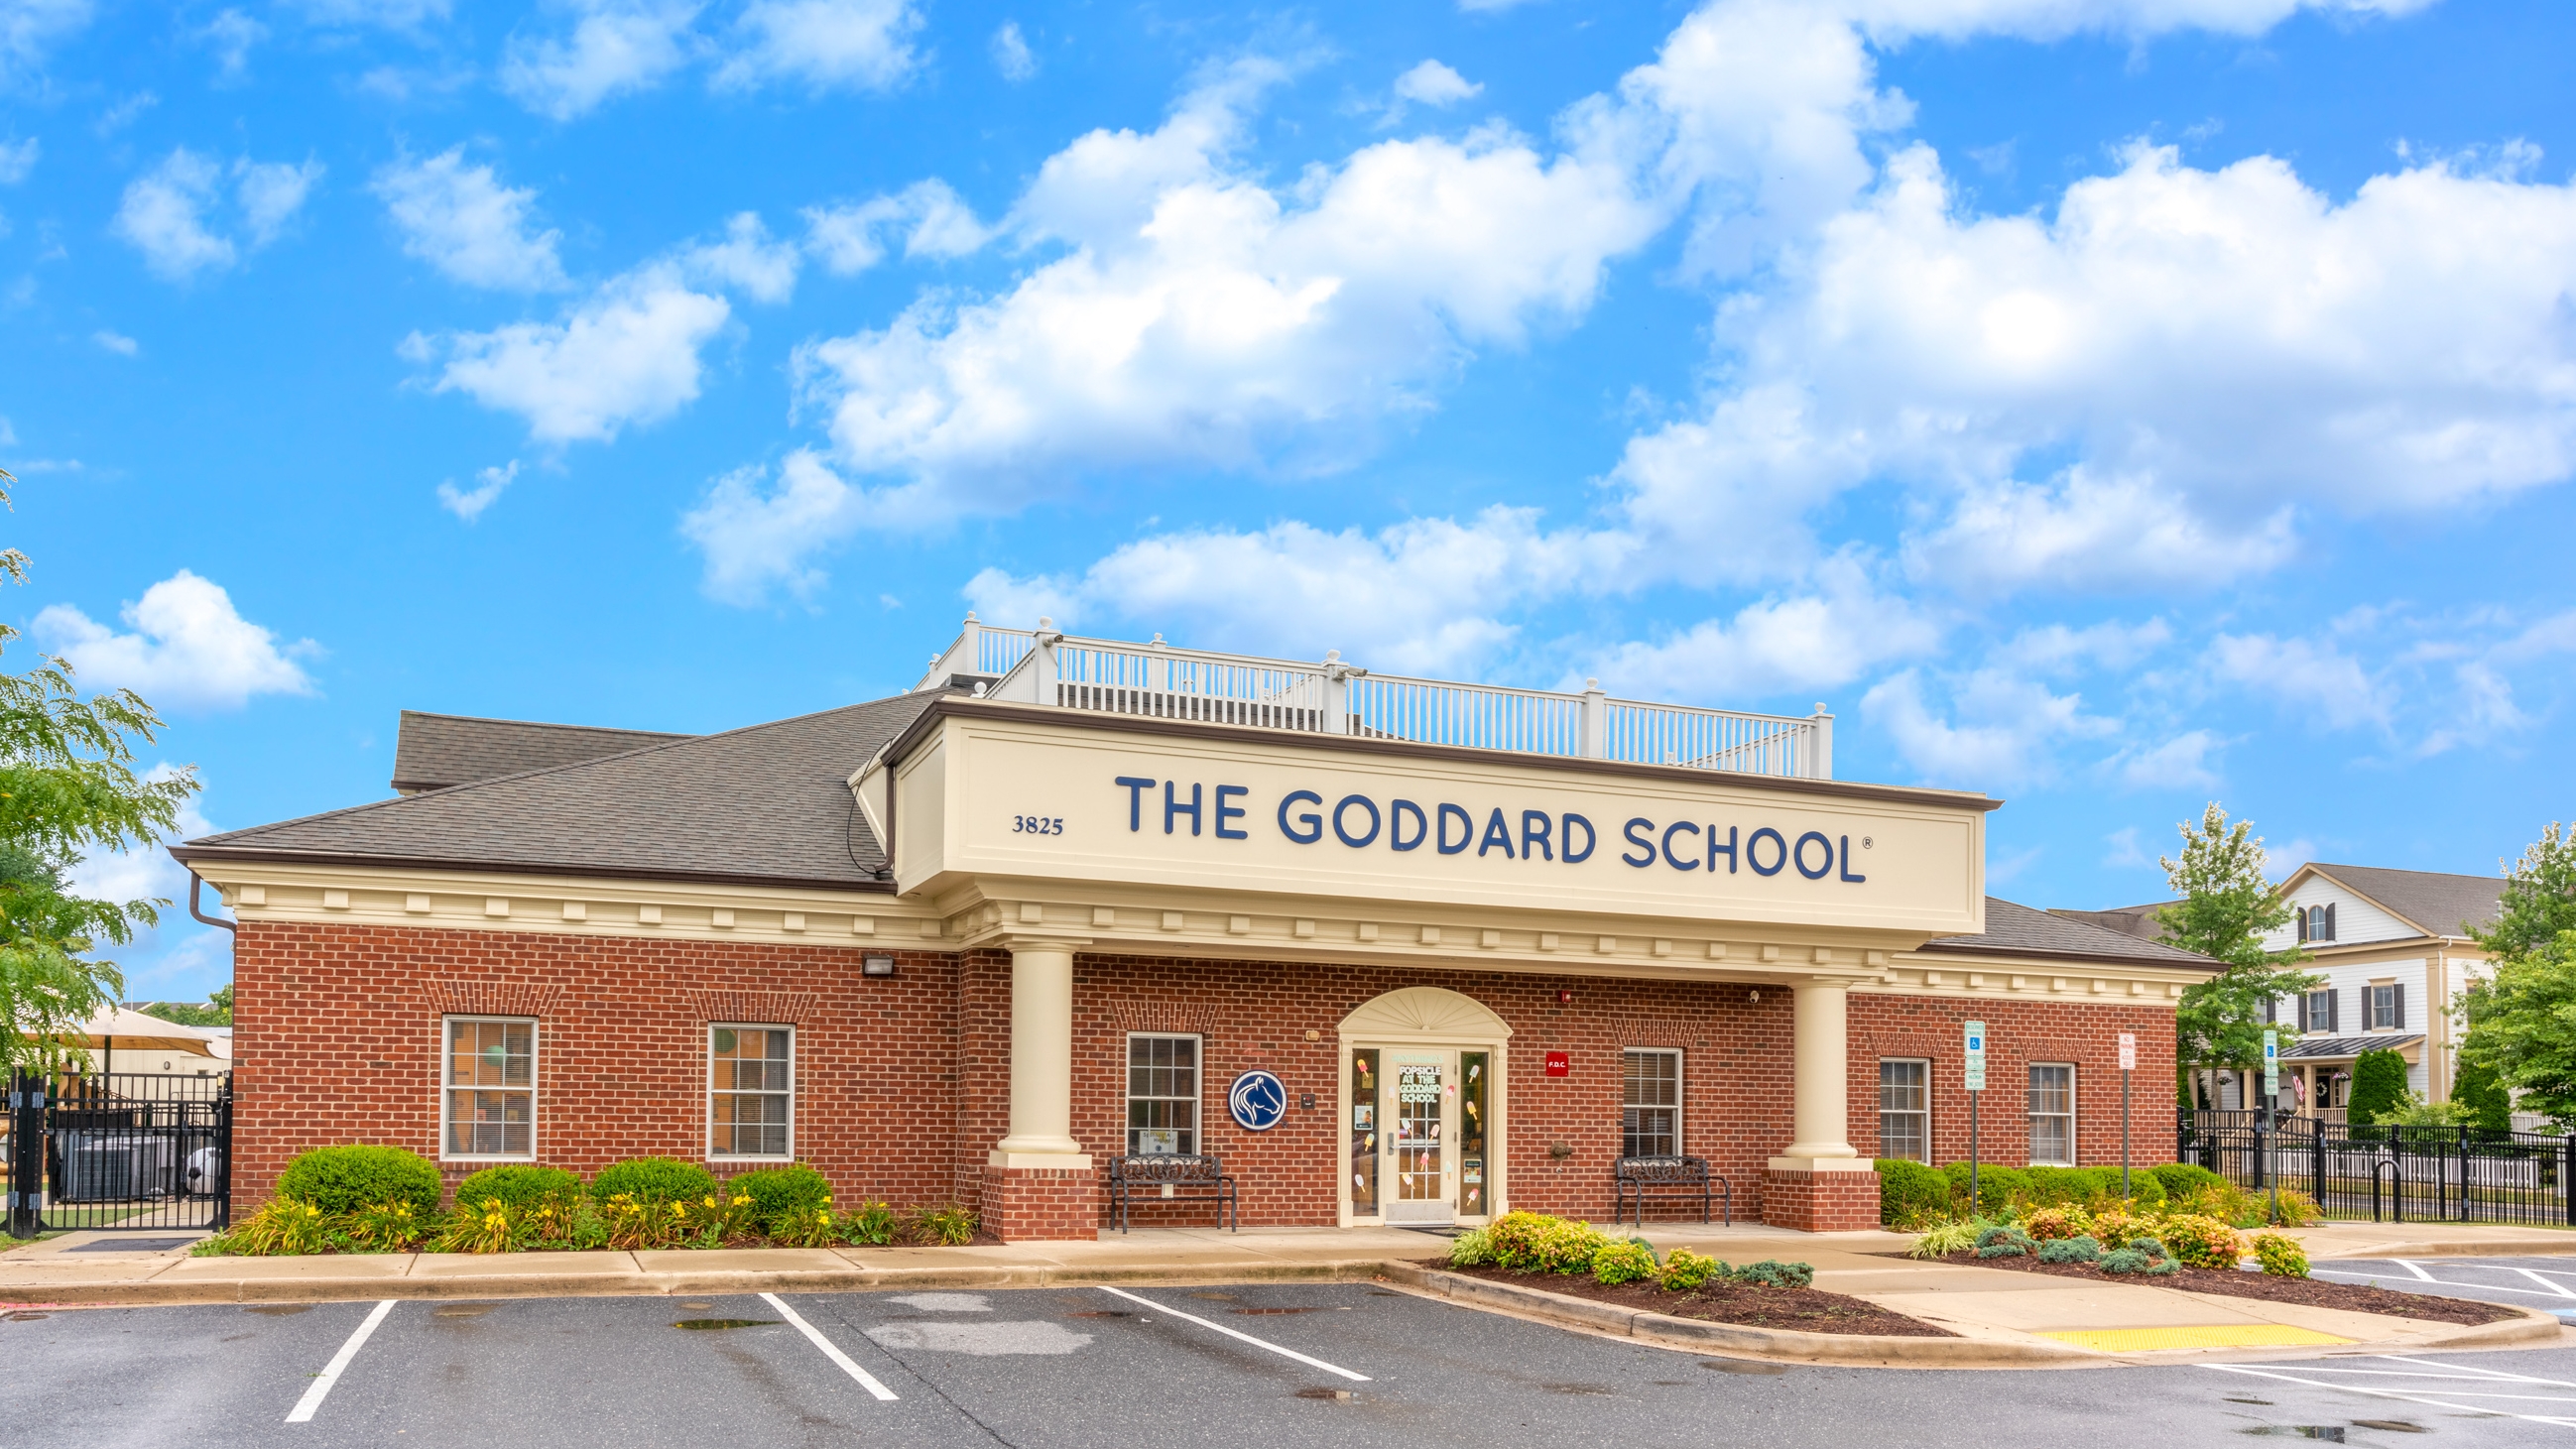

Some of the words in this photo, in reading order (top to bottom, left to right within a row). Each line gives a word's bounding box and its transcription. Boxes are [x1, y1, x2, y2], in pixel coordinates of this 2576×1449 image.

[1114, 776, 1249, 840] THE
[1277, 789, 1596, 864] GODDARD
[1012, 814, 1064, 836] 3825
[1400, 1066, 1441, 1075] POPSICLE
[1402, 1075, 1414, 1084] AT
[1417, 1075, 1436, 1084] THE
[1400, 1084, 1442, 1094] GODDARD
[1401, 1094, 1437, 1103] SCHOOL
